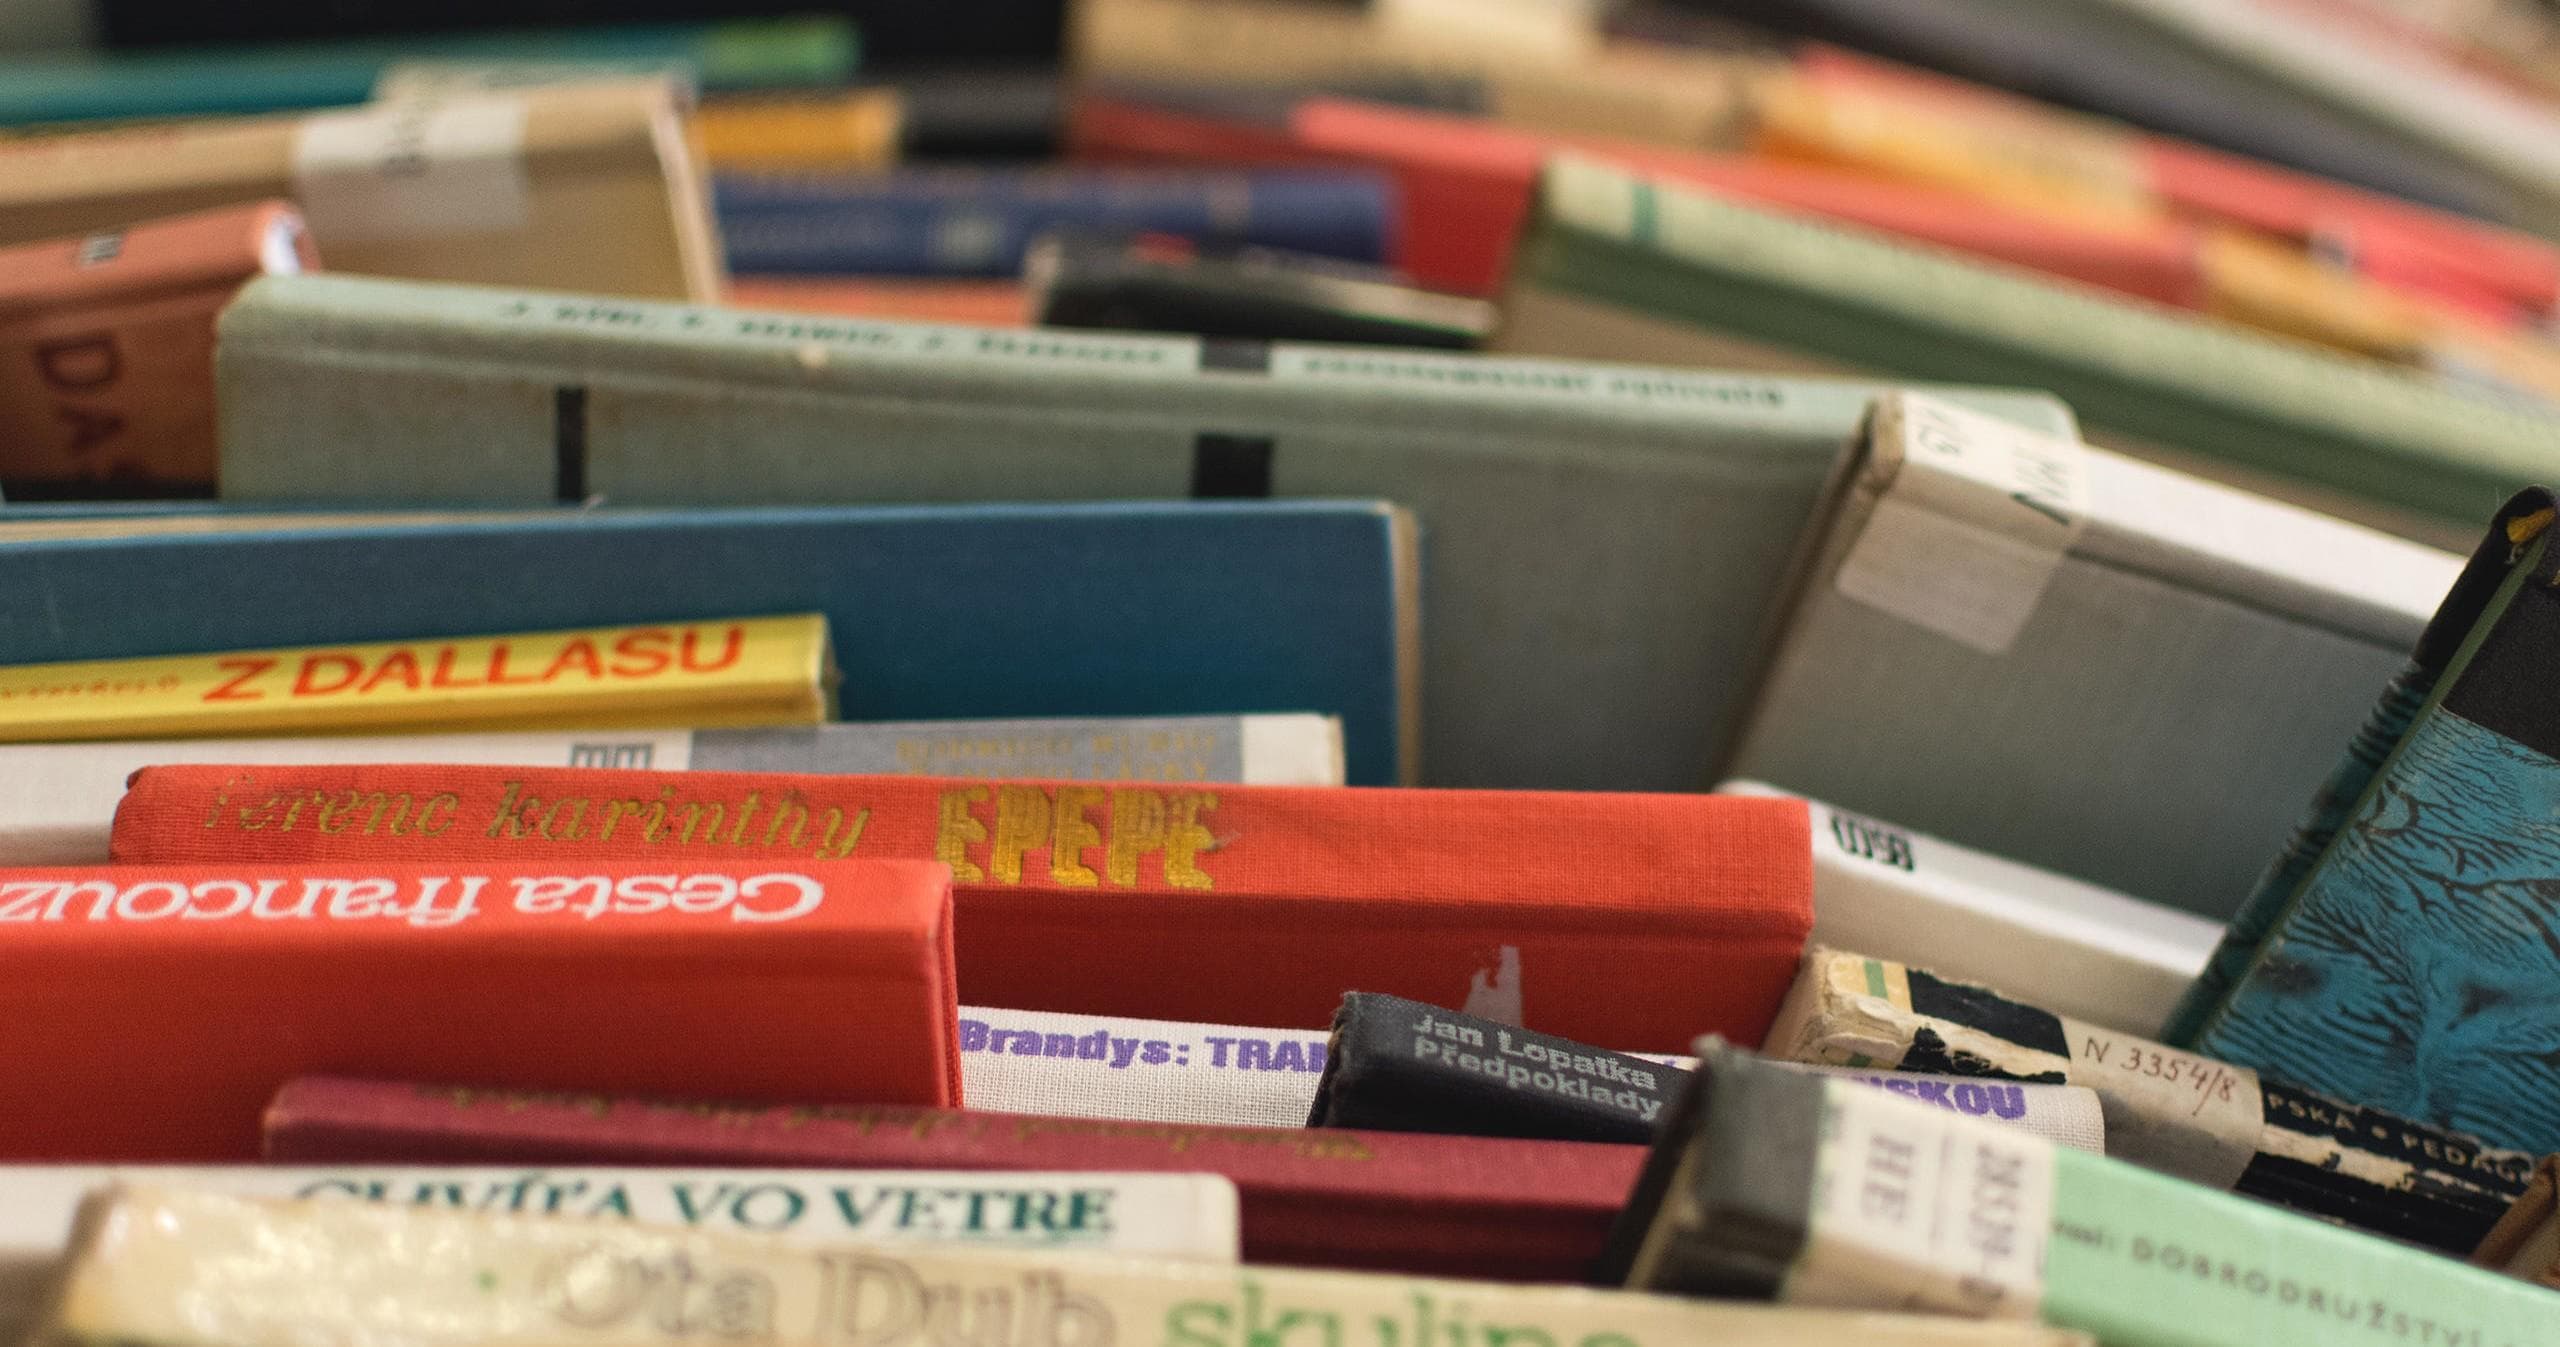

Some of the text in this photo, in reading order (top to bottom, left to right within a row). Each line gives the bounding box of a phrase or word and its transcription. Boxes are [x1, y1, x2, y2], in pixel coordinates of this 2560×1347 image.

[203, 656, 280, 701] Z
[291, 624, 745, 699] DALLASU
[487, 780, 872, 862] karinthy
[935, 783, 1220, 891] EPEPE
[0, 872, 825, 927] Cesta francouz
[1411, 1013, 1658, 1091] Jan Lopatka
[1413, 1035, 1663, 1122] Předpoklady
[2085, 1037, 2237, 1117] N 3354/8
[672, 1182, 809, 1229] VO
[829, 1183, 1117, 1234] VETRE
[813, 1252, 1116, 1347] Dub
